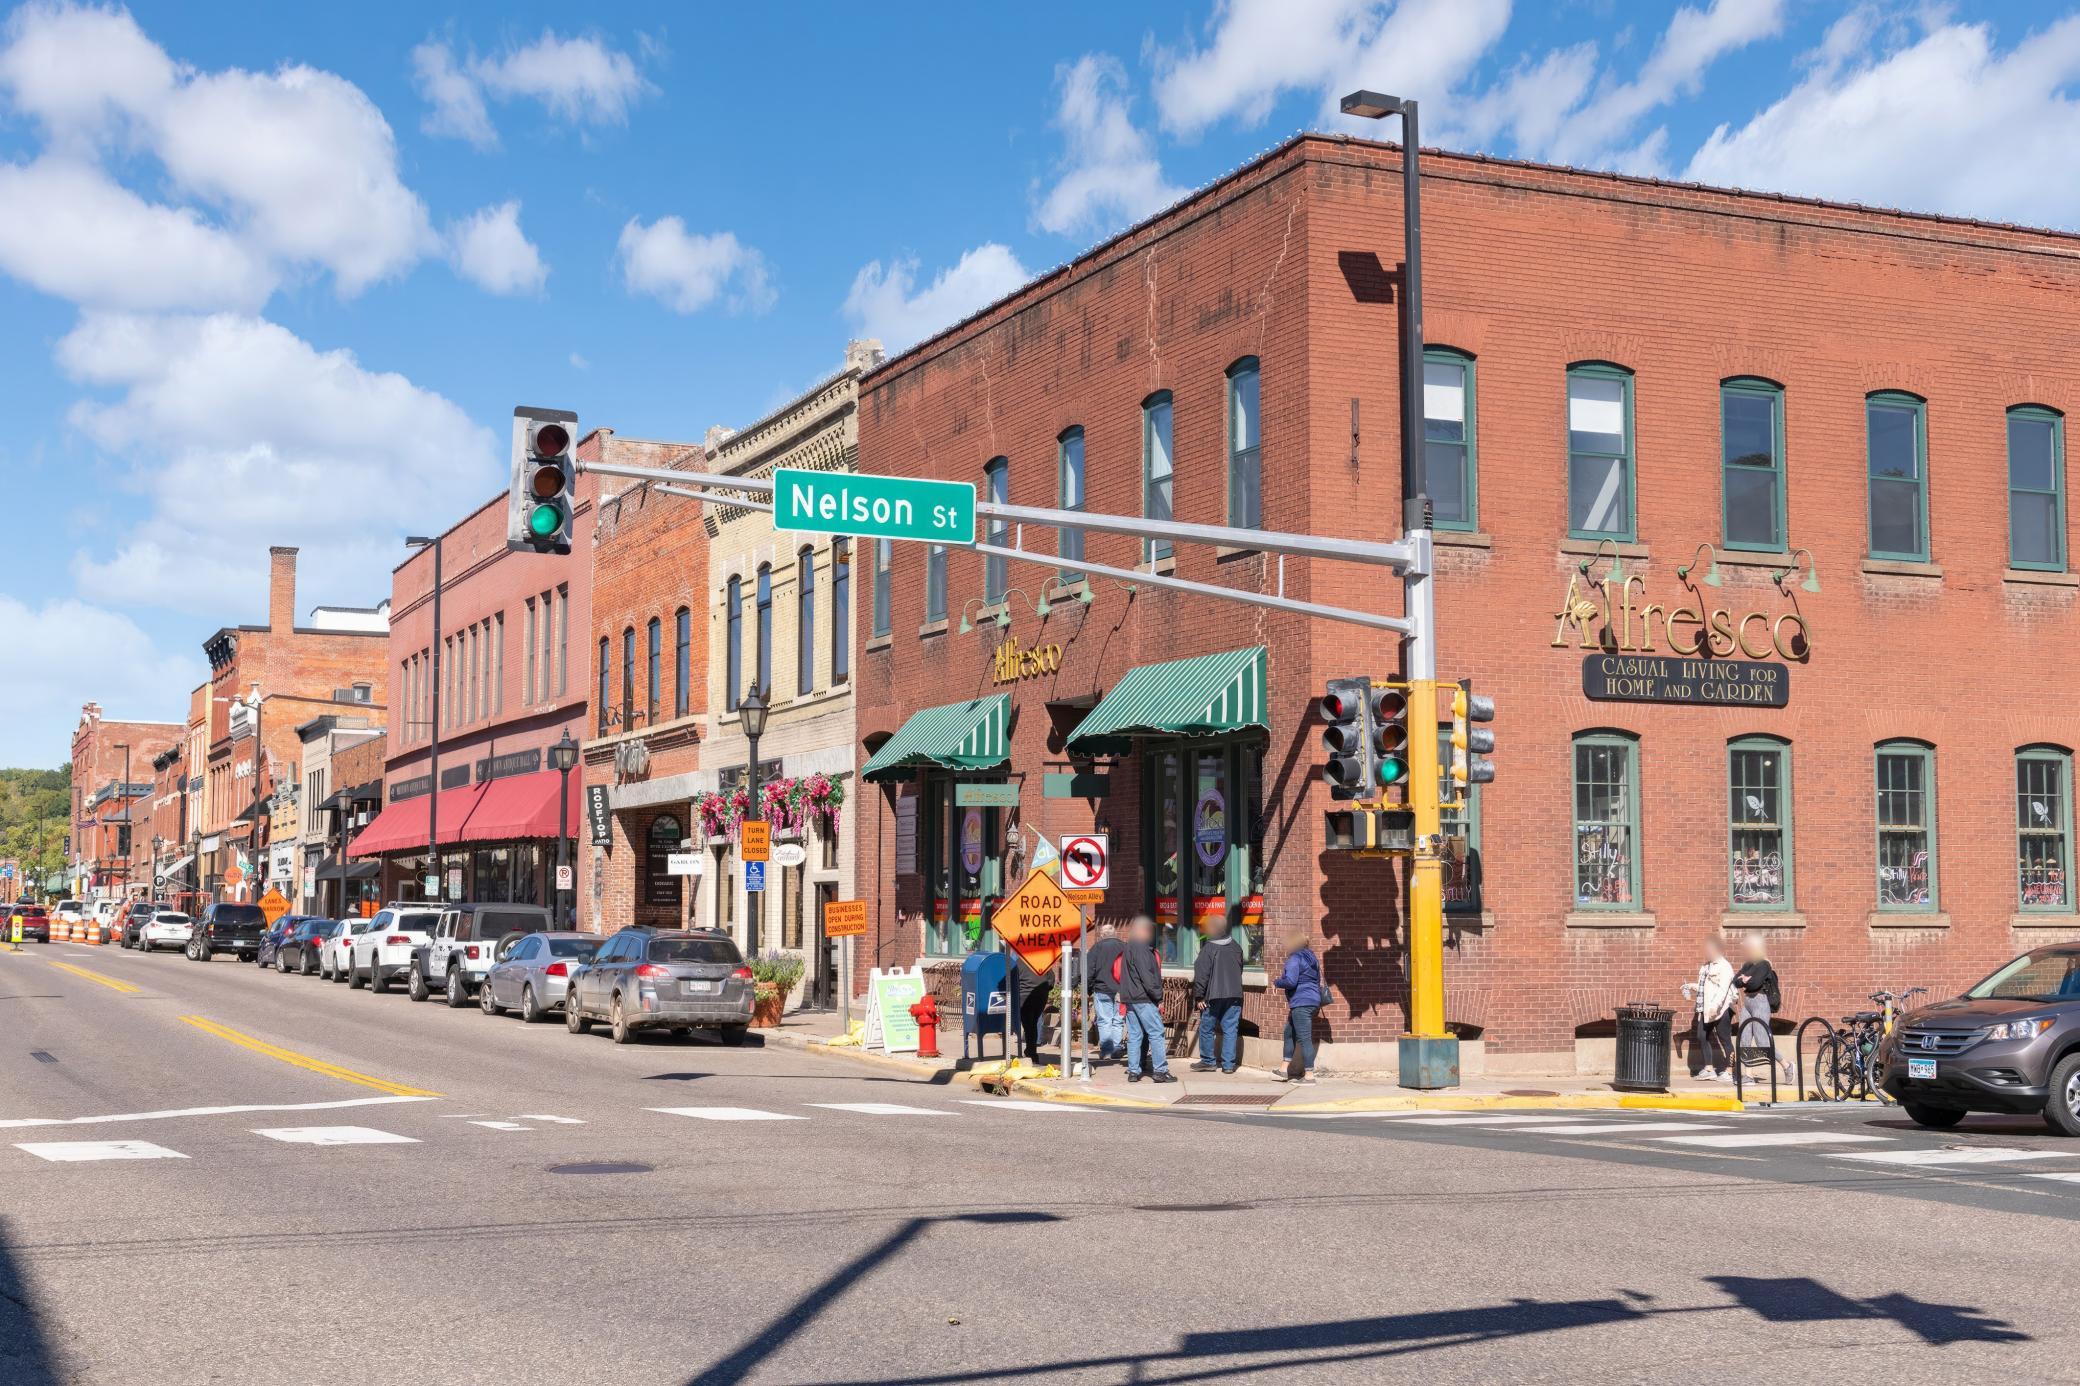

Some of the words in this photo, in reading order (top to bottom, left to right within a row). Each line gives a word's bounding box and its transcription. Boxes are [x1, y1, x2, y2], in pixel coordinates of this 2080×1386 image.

[791, 483, 913, 525] Nelson
[932, 505, 958, 529] St
[1551, 574, 1812, 660] Alfresco
[993, 635, 1062, 685] Alfresco
[1601, 657, 1668, 677] CASUAL
[1683, 662, 1740, 680] LIVING
[1751, 669, 1777, 683] FOR
[1605, 678, 1655, 696] HOME
[1664, 684, 1691, 698] AND
[1701, 683, 1774, 702] GARDEN
[593, 787, 606, 838] ROOFTOP
[1020, 895, 1062, 909] ROAD
[1088, 892, 1102, 900] Alley
[828, 915, 842, 923] OPEN
[844, 914, 864, 922] DURING
[828, 924, 865, 932] CONSTRUCTION
[1019, 914, 1062, 927] WORK
[1016, 933, 1067, 946] AHEAD
